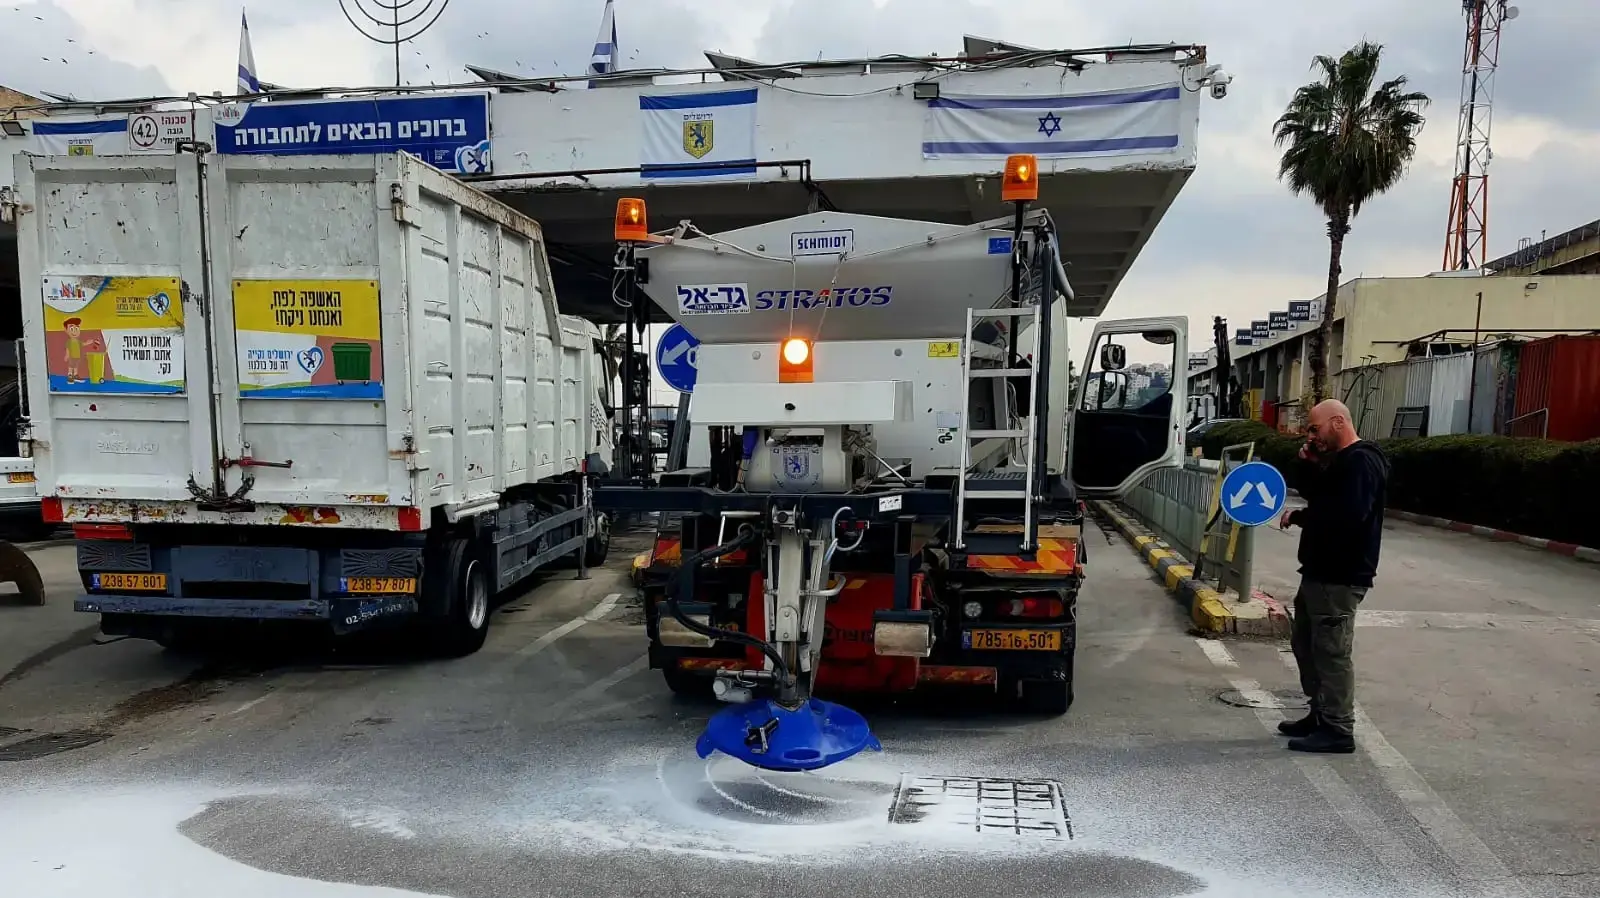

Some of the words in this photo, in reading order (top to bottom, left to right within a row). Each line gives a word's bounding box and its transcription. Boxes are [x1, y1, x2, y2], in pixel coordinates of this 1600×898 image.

[161, 116, 187, 125] סכנה!
[167, 127, 183, 135] גובה
[235, 121, 321, 146] לתחבורה
[327, 122, 392, 141] הבאים
[398, 118, 467, 138] ברוכים
[797, 236, 847, 250] SCHMIDT
[299, 291, 341, 307] האשפה
[677, 285, 748, 306] גד-אל
[755, 286, 893, 310] STRATOS
[275, 309, 304, 327] ניקח!
[309, 309, 342, 326] ואנחנו
[150, 336, 171, 347] אנחנו
[123, 349, 151, 361] תשאירו
[154, 349, 171, 361] אתם
[247, 349, 265, 360] נקייה
[267, 349, 294, 360] ירושלים
[248, 360, 267, 370] כולנו!
[269, 360, 278, 370] על
[280, 361, 289, 370] זה
